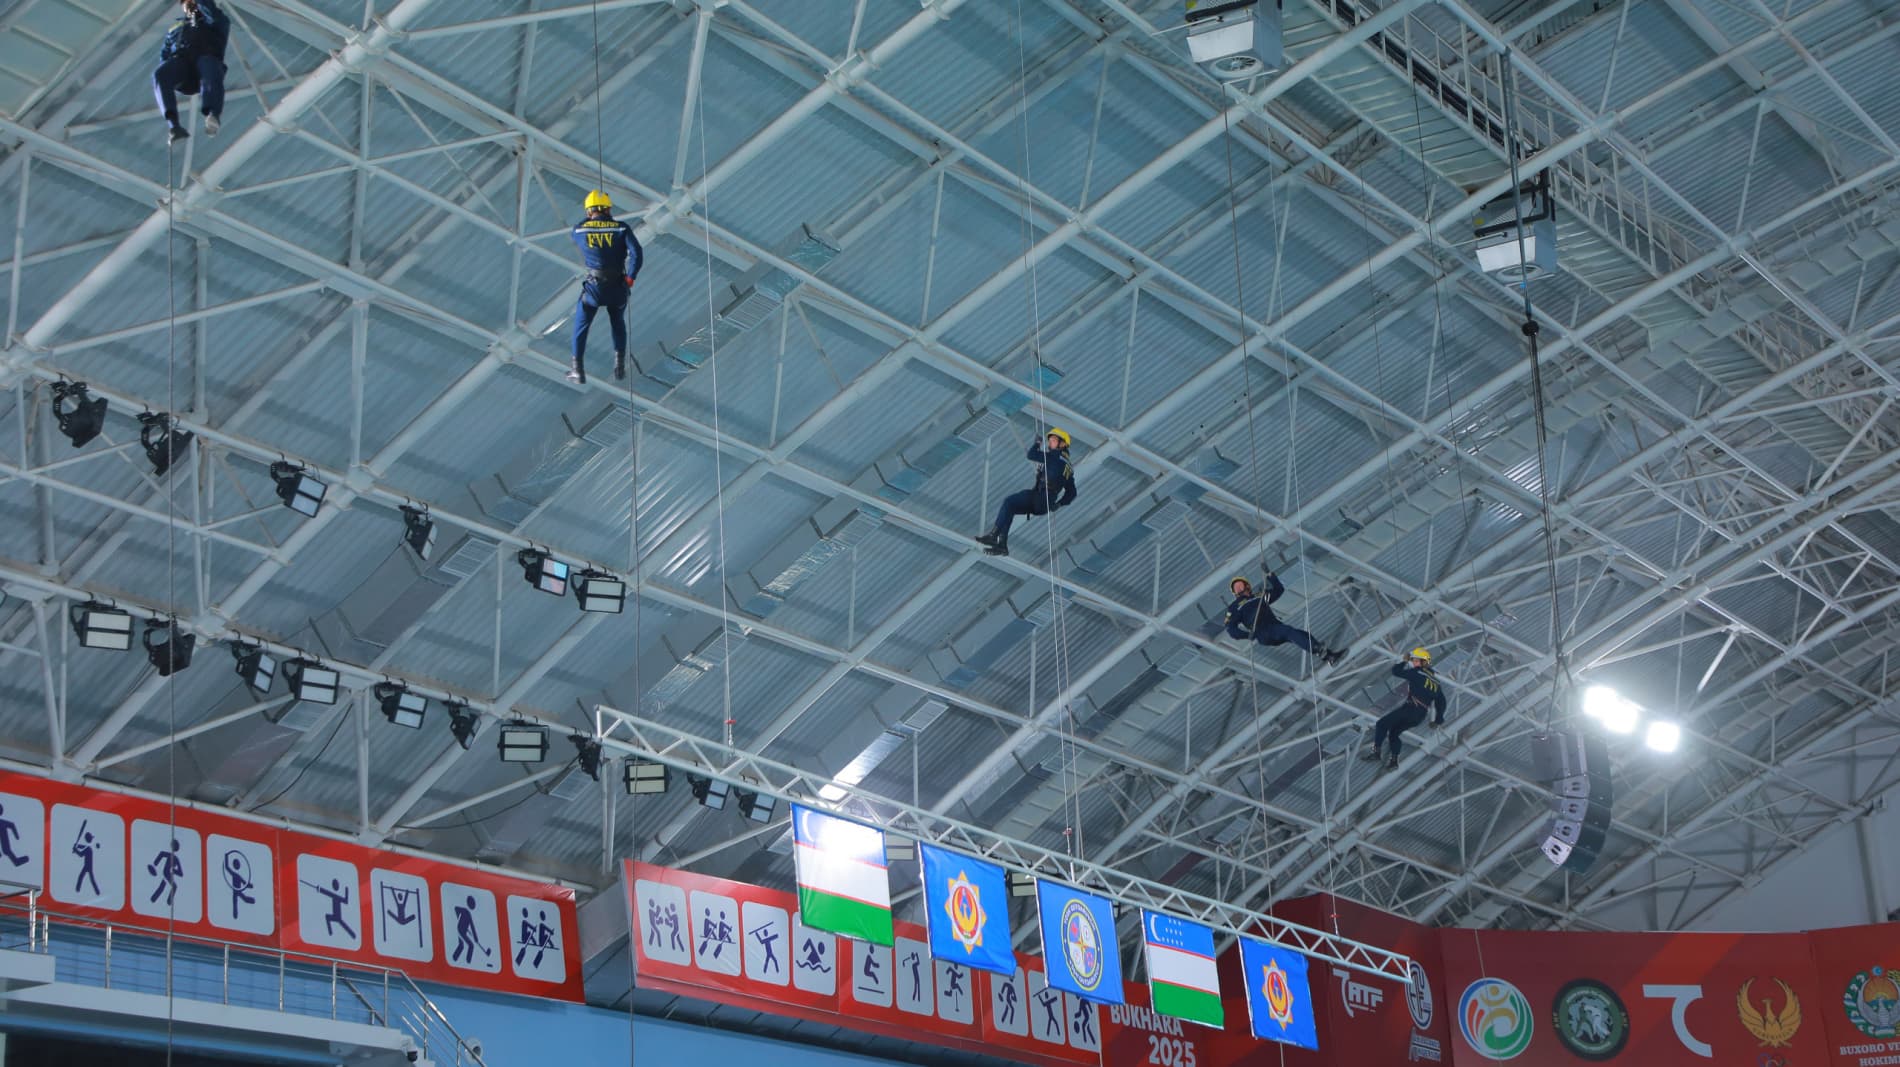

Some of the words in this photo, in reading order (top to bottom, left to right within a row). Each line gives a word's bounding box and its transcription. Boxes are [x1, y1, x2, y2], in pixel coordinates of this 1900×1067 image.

[1110, 1003, 1184, 1037] BUKHARA
[1148, 1035, 1196, 1067] 2025
[1840, 1044, 1885, 1055] BUXORO
